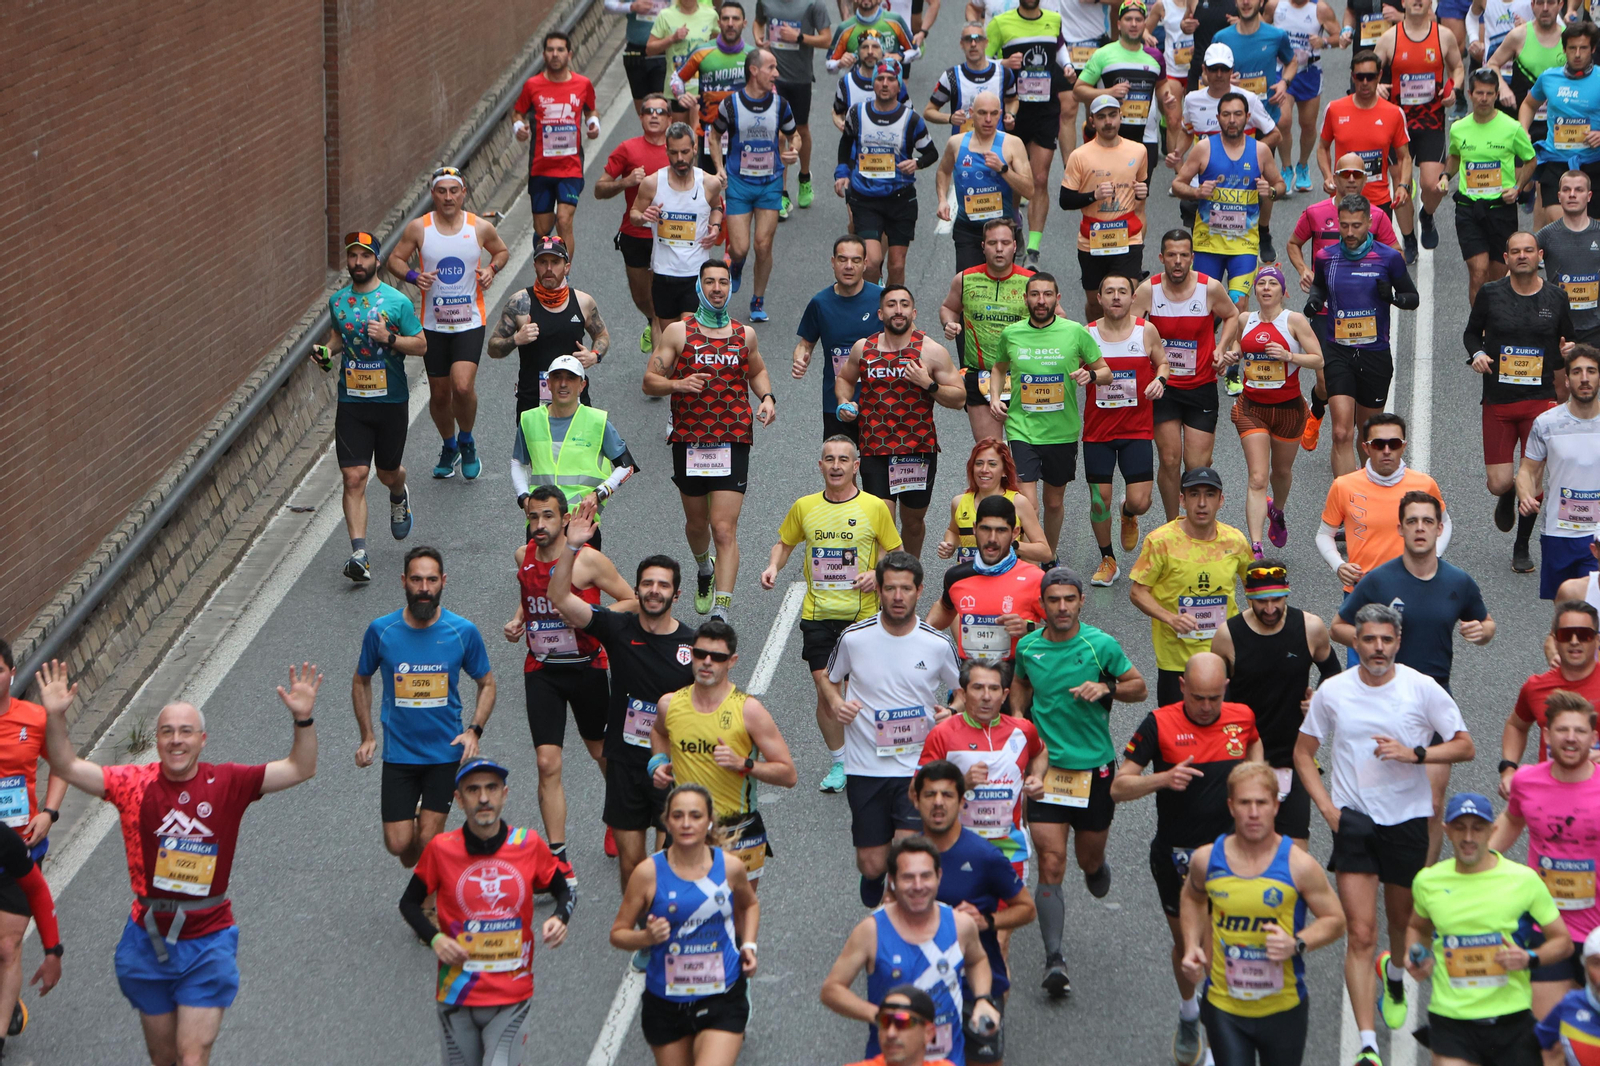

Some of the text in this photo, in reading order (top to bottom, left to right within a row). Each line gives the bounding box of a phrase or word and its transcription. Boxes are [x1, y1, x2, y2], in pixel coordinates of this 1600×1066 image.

[976, 186, 997, 194] ZURICH
[972, 205, 996, 213] FRANCISCO
[1102, 222, 1123, 230] ZURICH
[439, 264, 463, 275] vista
[1035, 347, 1060, 355] aecc
[695, 353, 739, 365] KENYA
[1514, 360, 1529, 368] 6237
[357, 373, 372, 381] 3754
[1035, 375, 1060, 383] ZURICH
[900, 467, 914, 475] 7194
[1574, 491, 1600, 499] ZURICH
[1573, 504, 1589, 512] 7396
[827, 563, 842, 571] 7000
[1196, 597, 1222, 606] ZURICH
[1195, 611, 1211, 619] 6980
[977, 631, 994, 639] 9417
[412, 664, 442, 672] ZURICH
[892, 709, 921, 719] ZURICH
[893, 724, 911, 734] 7164
[893, 737, 913, 745] BORJA
[1055, 774, 1074, 783] 4182
[978, 790, 1008, 799] ZURICH
[977, 807, 996, 816] 6951
[179, 842, 212, 854] ZURICH
[168, 872, 199, 883] ALBERTO
[483, 920, 516, 931] ZURICH
[684, 944, 717, 954] ZURICH
